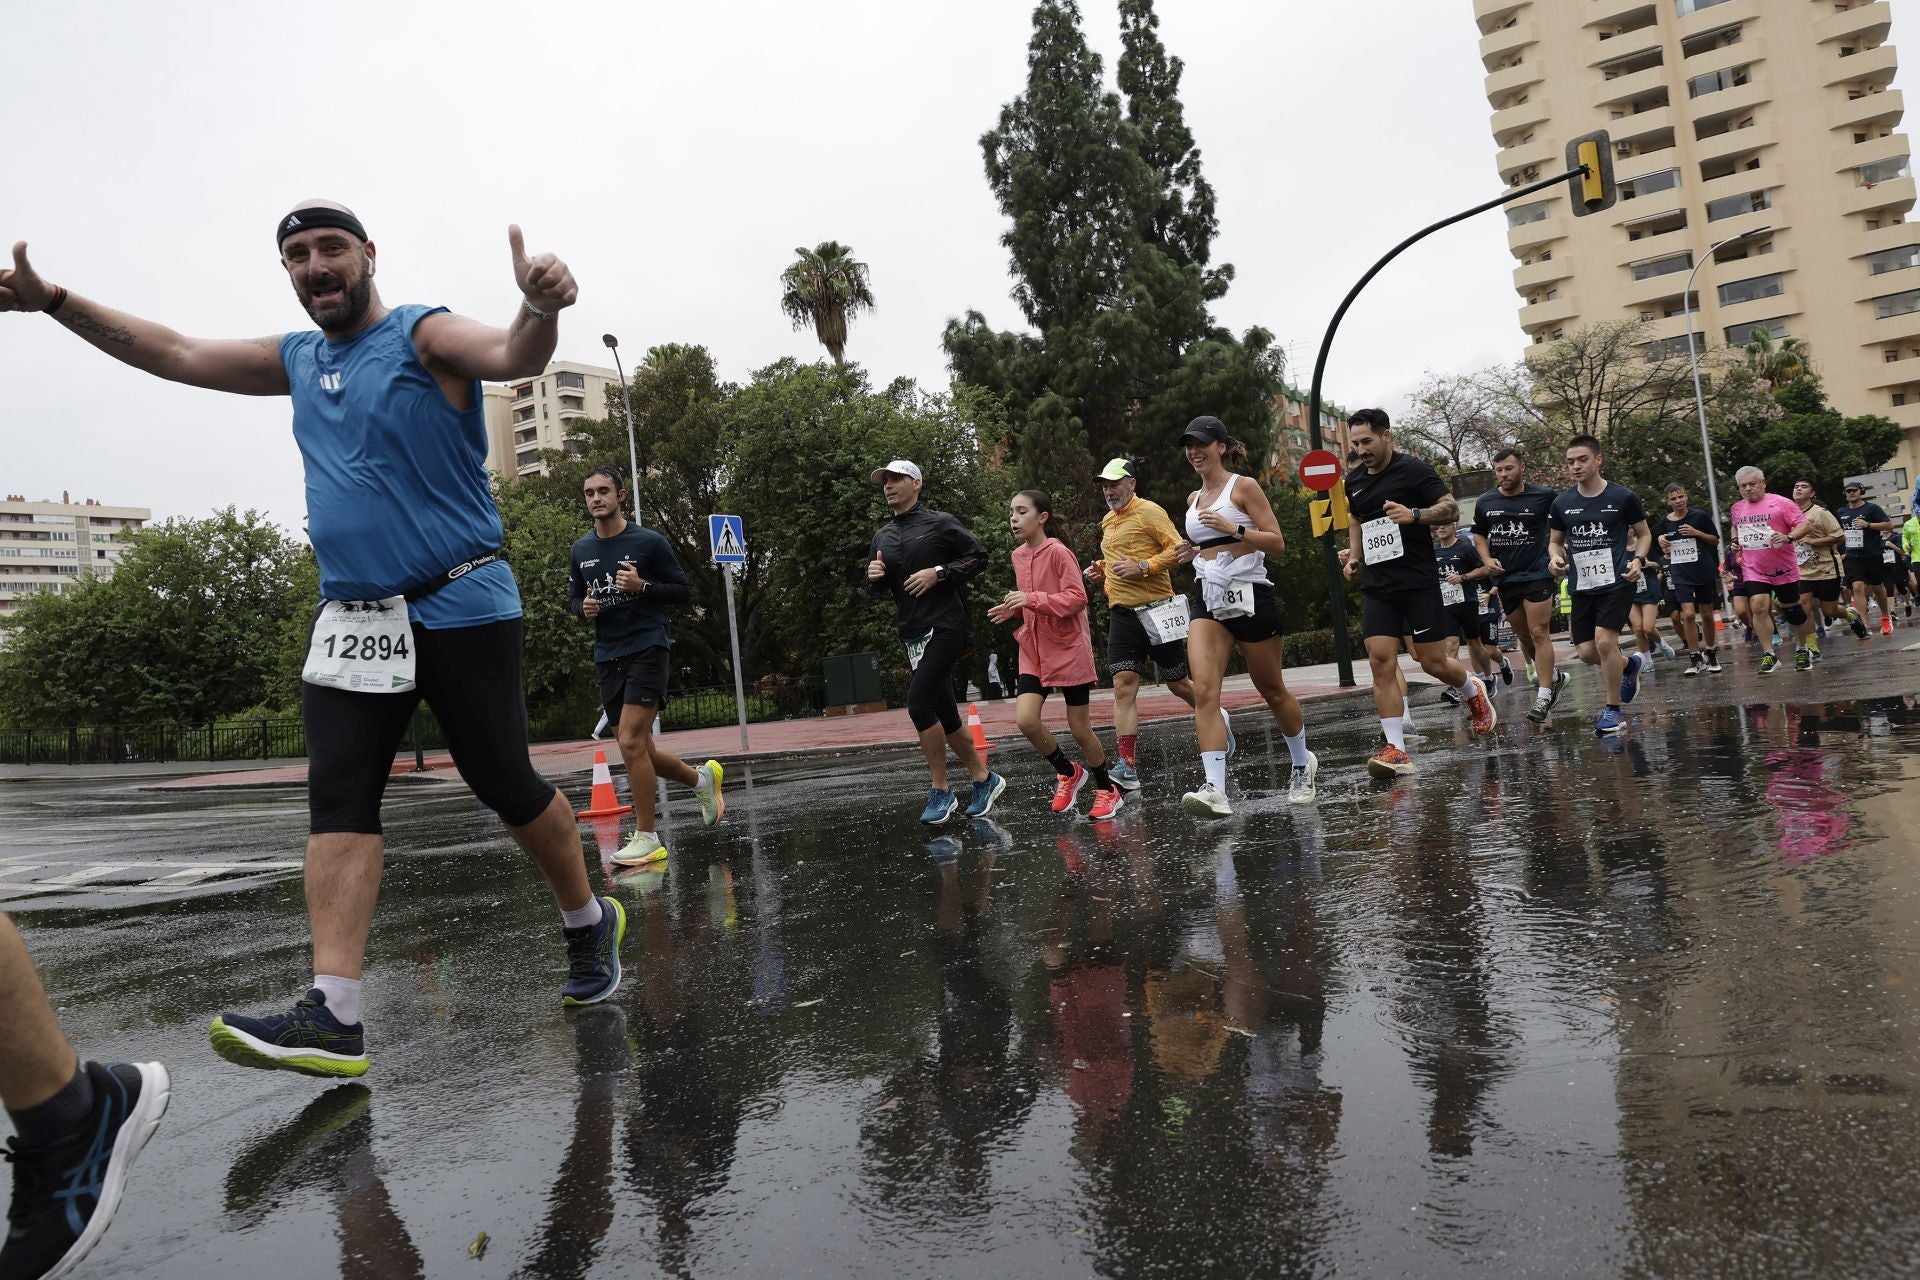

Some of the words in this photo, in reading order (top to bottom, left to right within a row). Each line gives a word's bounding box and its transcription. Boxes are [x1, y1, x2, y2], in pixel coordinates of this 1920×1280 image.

[1367, 533, 1394, 550] 3860
[1743, 533, 1765, 542] 6792
[1581, 563, 1607, 577] 3713
[1223, 589, 1244, 605] 81
[1161, 615, 1186, 630] 3783
[323, 633, 409, 661] 12894
